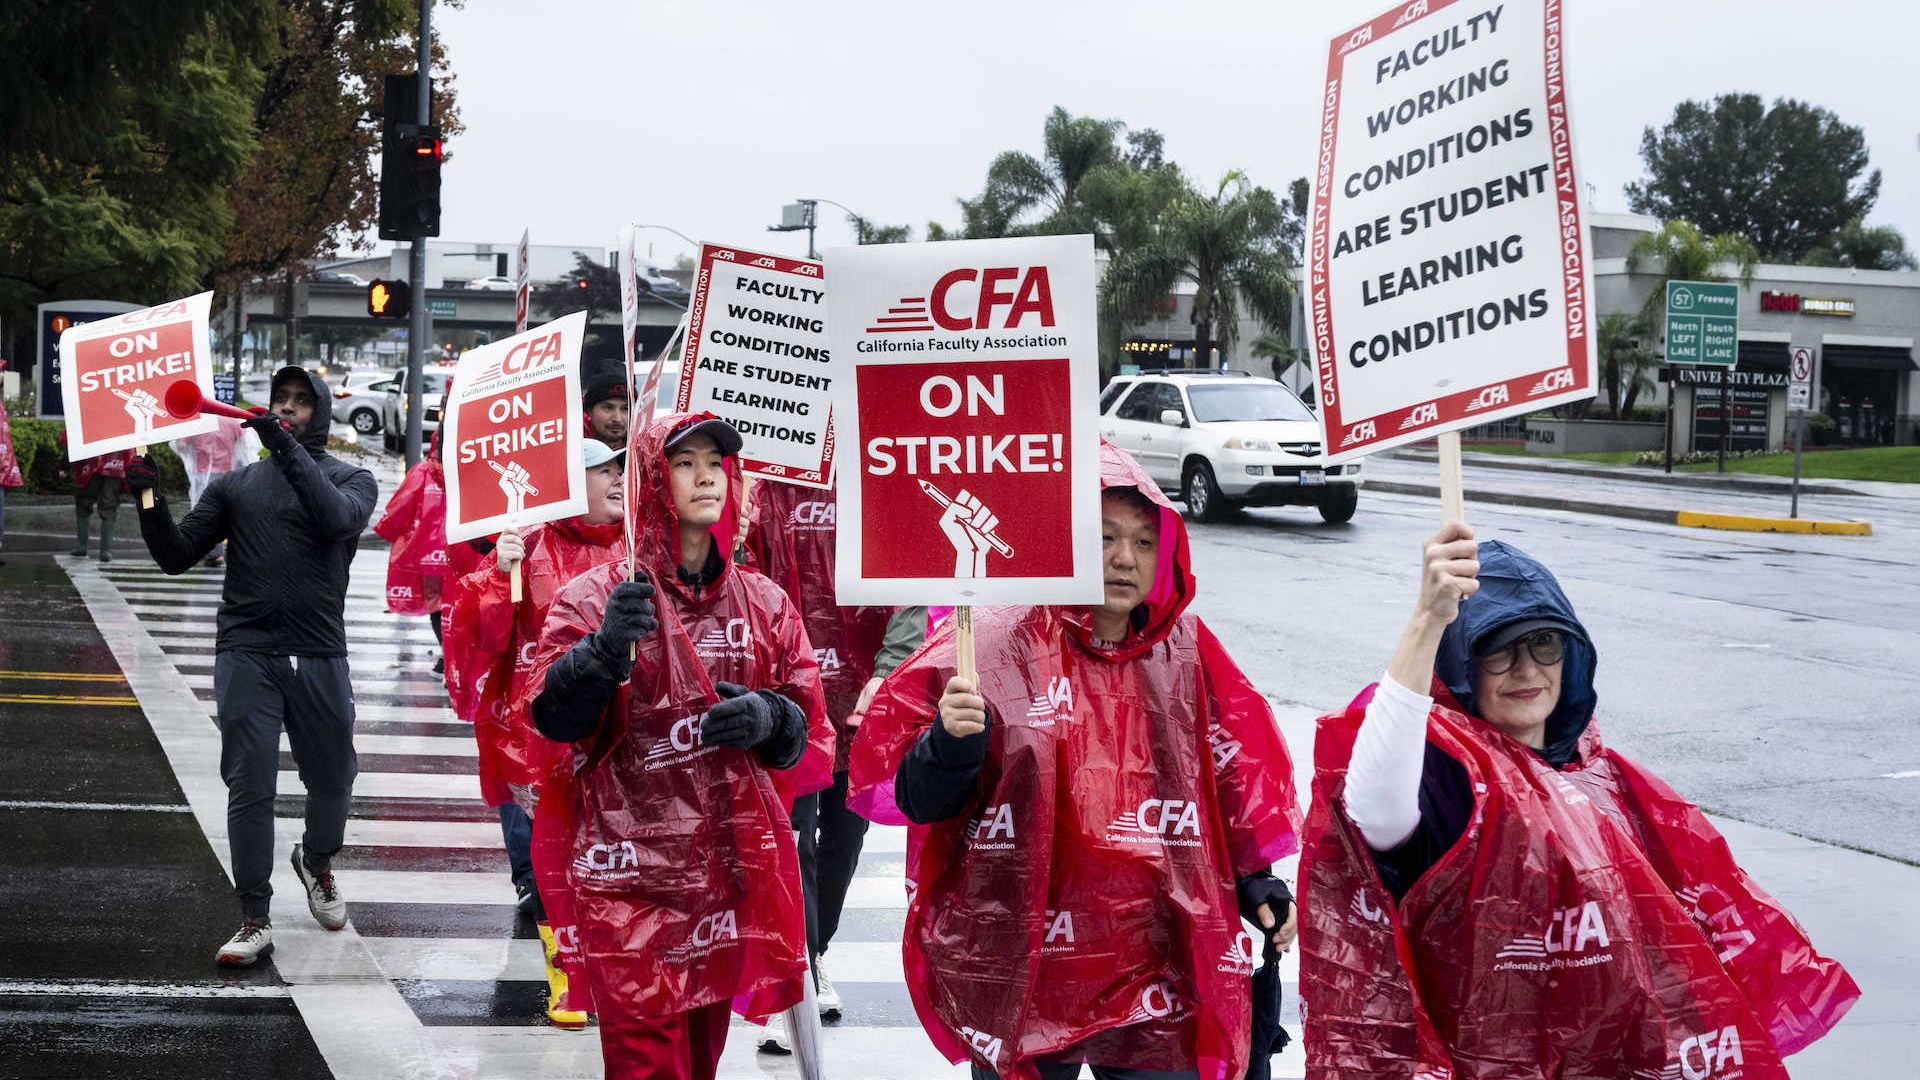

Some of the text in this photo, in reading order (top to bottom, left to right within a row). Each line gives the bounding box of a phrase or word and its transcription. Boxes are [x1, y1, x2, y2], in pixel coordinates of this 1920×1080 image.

[1350, 25, 1373, 46] CFA
[1375, 4, 1504, 84] FACULTY
[1366, 59, 1510, 138] WORKING
[1344, 107, 1534, 198] CONDITIONS
[1550, 102, 1573, 193] FACULTY
[1333, 164, 1549, 259] ARE STUDENT
[1312, 80, 1338, 406] CALIFORNIA FACULTY ASSOCIATION
[717, 250, 818, 277] CFA CFA CFA
[1361, 234, 1524, 307] LEARNING
[1560, 200, 1584, 340] ASSOCIATION
[736, 277, 825, 304] FACULTY
[930, 265, 1056, 331] CFA
[1675, 294, 1735, 306] 57 Freeway
[57, 319, 63, 331] 1
[121, 302, 187, 324] CFA
[683, 333, 699, 377] FACULTY
[691, 269, 709, 334] ASSOCIATION
[728, 304, 824, 333] WORKING
[1349, 289, 1549, 368] CONDITIONS
[1671, 322, 1698, 331] North
[1707, 324, 1734, 333] South
[109, 332, 158, 357] ON
[502, 332, 562, 375] CFA
[710, 330, 830, 363] CONDITIONS
[856, 334, 1067, 353] California Faculty Association
[1671, 347, 1696, 356] LANE
[1672, 335, 1696, 343] LEFT
[1705, 336, 1733, 345] RIGHT
[1706, 349, 1732, 357] LANE
[80, 351, 192, 392] STRIKE!
[461, 363, 565, 398] California Faculty Association
[698, 357, 832, 391] ARE STUDENT
[1680, 369, 1791, 386] UNIVESITY PLAZA
[488, 391, 533, 424] ON
[711, 387, 810, 416] LEARNING
[919, 374, 1005, 418] ON
[1352, 368, 1576, 443] CFA CFA CFA CFA
[460, 418, 563, 464] STRIKE!
[867, 433, 1063, 476] STRIKE!
[768, 465, 822, 482] CFA CFA
[390, 586, 412, 598] CFA
[814, 648, 840, 670] FA
[670, 712, 710, 752] CF
[644, 758, 675, 772] California
[973, 803, 1015, 839] FA
[1137, 798, 1201, 837] CFA
[973, 842, 1015, 850] Association
[1105, 833, 1137, 843] California
[586, 840, 639, 871] CFA
[693, 909, 738, 948] CFA
[1679, 1025, 1744, 1080] CFA
